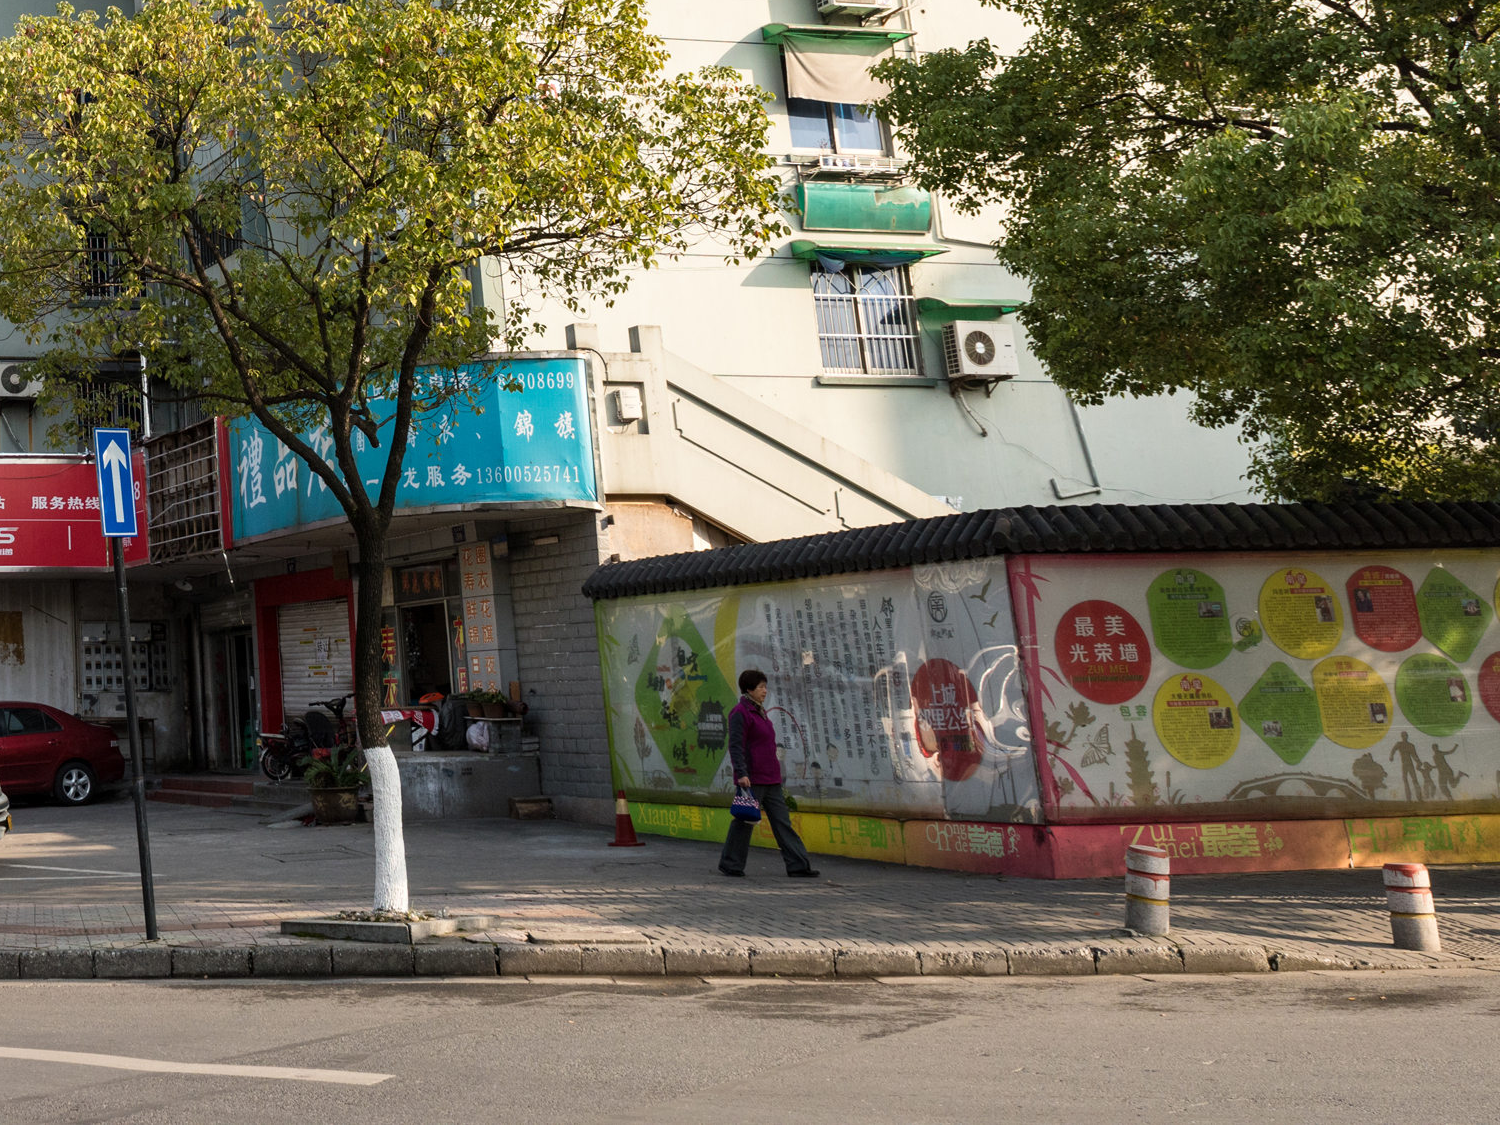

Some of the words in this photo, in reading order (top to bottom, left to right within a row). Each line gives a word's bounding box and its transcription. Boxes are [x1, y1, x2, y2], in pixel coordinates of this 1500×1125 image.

[498, 372, 575, 390] 8808699
[477, 465, 580, 484] 13600525741
[32, 495, 100, 510] 服务热线
[462, 544, 487, 567] 花圈
[463, 570, 489, 591] 寿衣
[465, 598, 492, 620] 鲜花
[467, 623, 494, 644] 锦旗
[1073, 615, 1127, 638] 最美
[1068, 642, 1140, 664] 光荣墙
[470, 654, 497, 675] 日夜
[1087, 665, 1104, 674] ZUI
[1109, 664, 1129, 674] MEI
[928, 683, 959, 707] 上城
[917, 708, 976, 733] 邻里公约
[1119, 704, 1148, 717] 包容
[638, 803, 678, 835] Xiang
[955, 836, 968, 853] de
[967, 824, 1005, 858] 崇德
[1199, 824, 1262, 859] 最美
